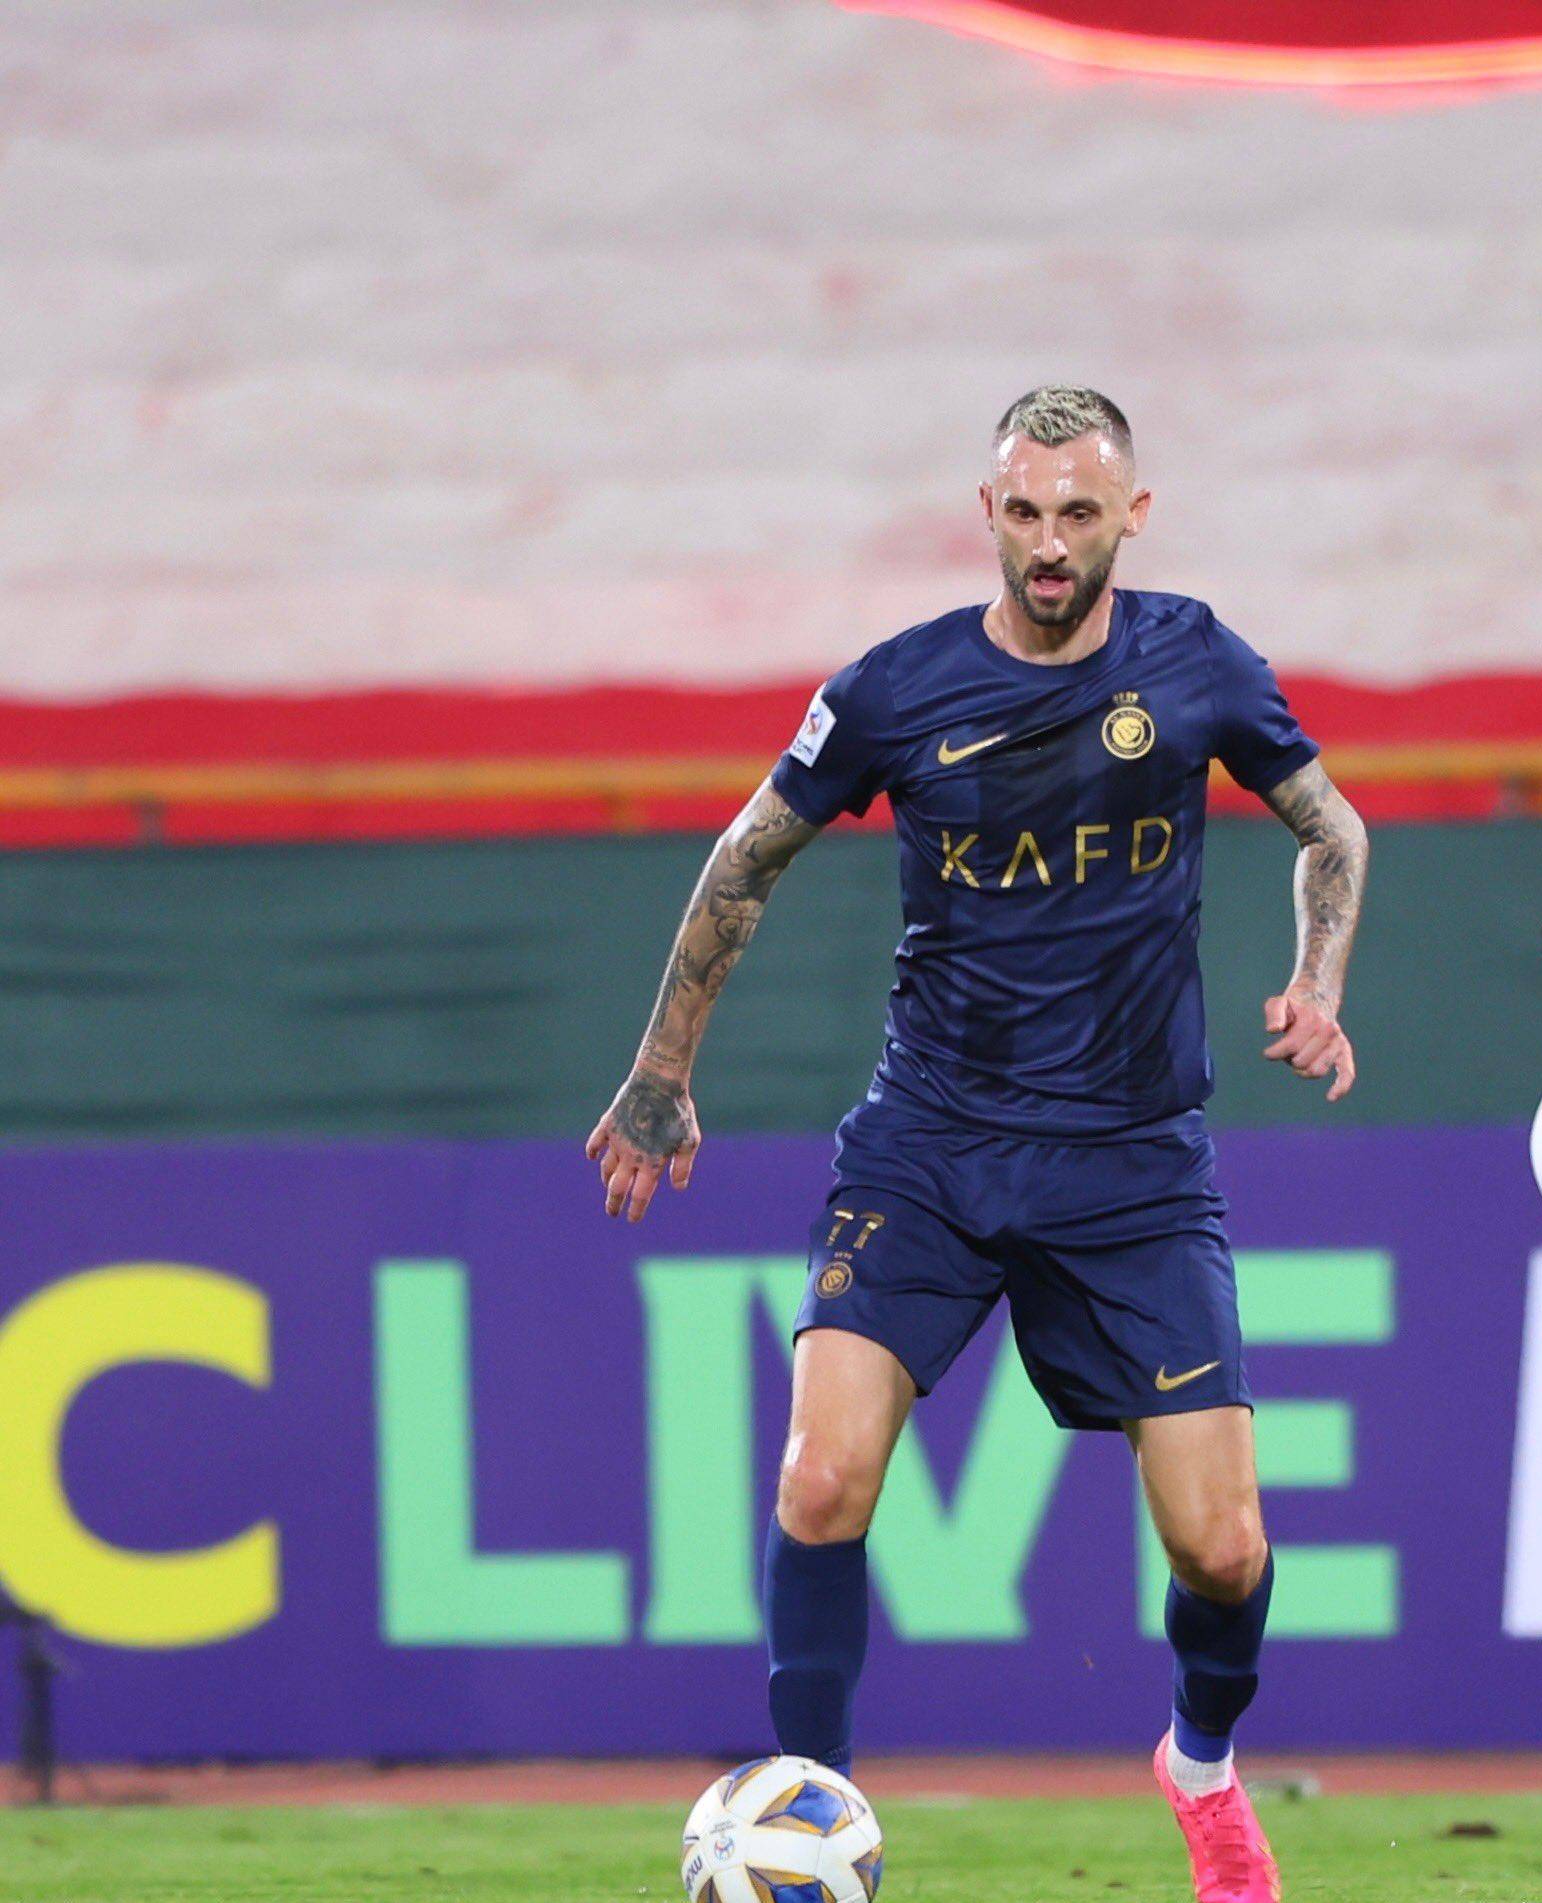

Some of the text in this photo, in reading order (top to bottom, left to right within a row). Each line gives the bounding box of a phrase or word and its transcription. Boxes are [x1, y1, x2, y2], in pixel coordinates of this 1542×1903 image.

[940, 815, 1173, 889] KAFD
[826, 1209, 886, 1249] 77
[374, 1249, 1402, 1644] LIVE
